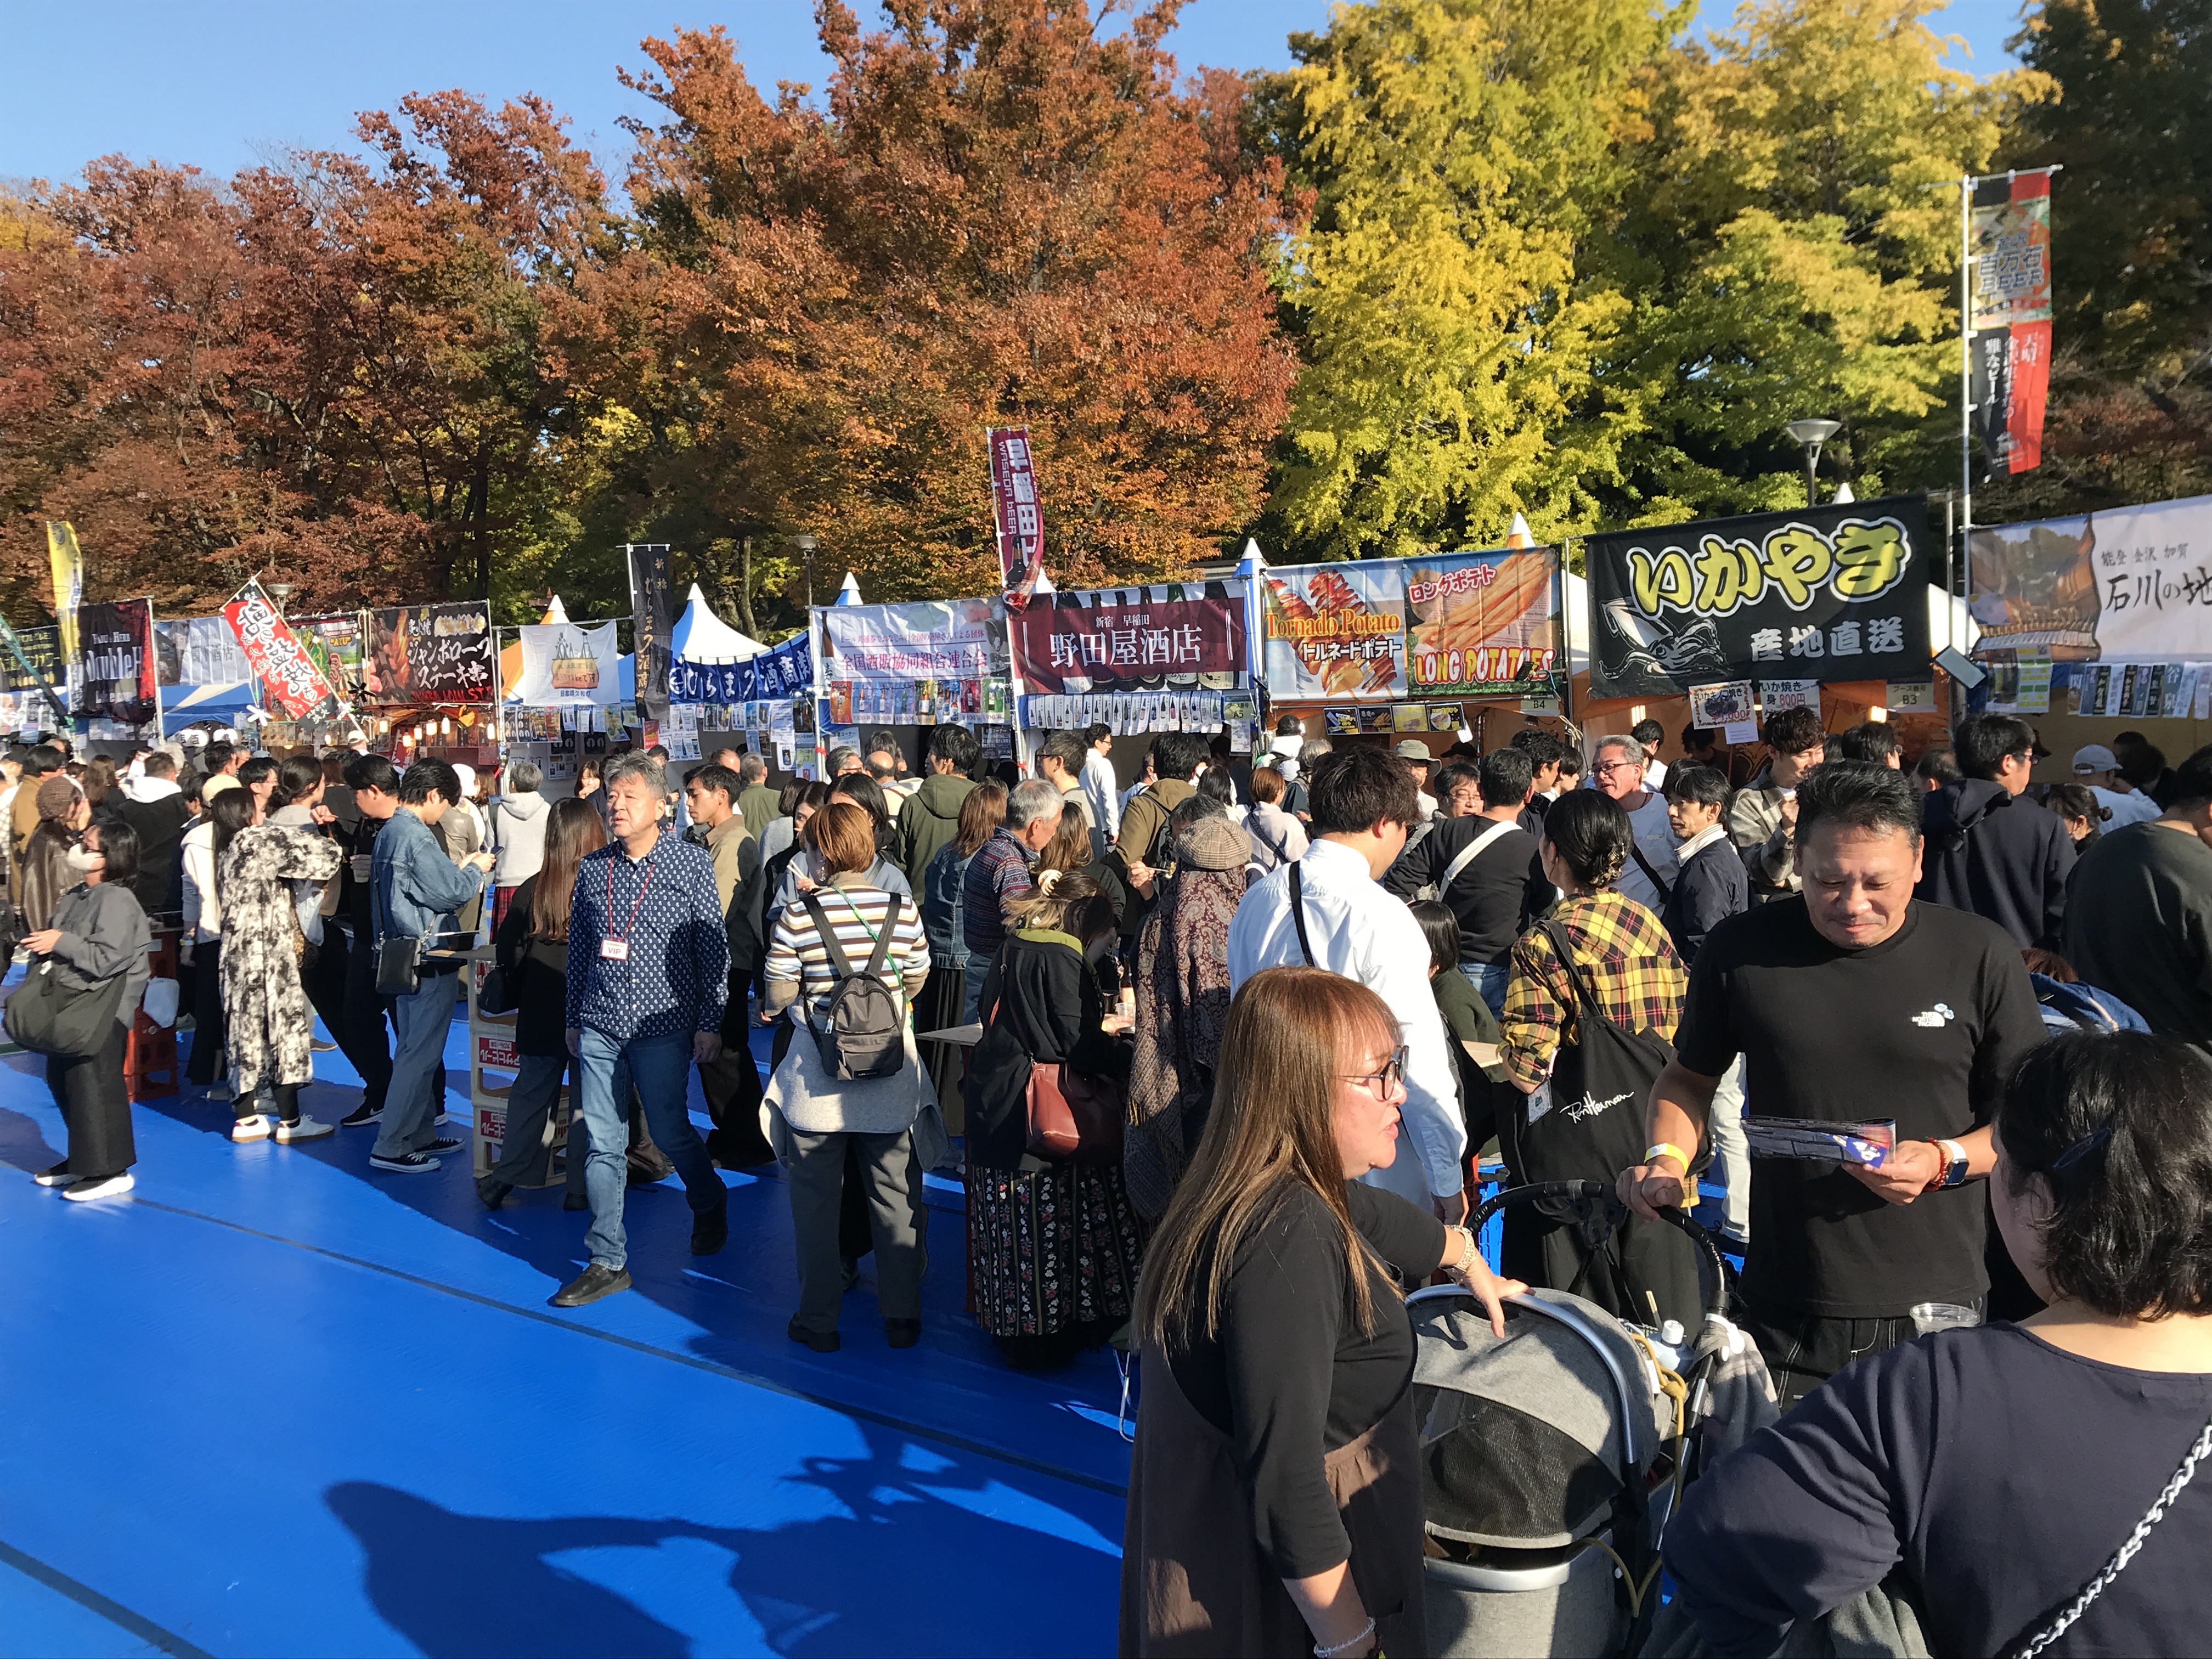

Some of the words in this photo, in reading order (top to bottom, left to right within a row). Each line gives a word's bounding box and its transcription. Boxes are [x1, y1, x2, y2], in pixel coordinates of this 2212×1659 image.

[1980, 245, 2045, 274] 百万石
[1981, 269, 2043, 292] BEER
[2102, 549, 2127, 566] 能登
[2135, 546, 2157, 563] 金沢
[2164, 543, 2188, 559] 加賀
[1627, 518, 1909, 617] いかやき
[1410, 564, 1497, 603] ロングポテト
[2105, 566, 2212, 613] 石川の地
[1095, 617, 1113, 629] 新宿
[1123, 614, 1150, 627] 早稲田
[1266, 611, 1338, 637] Tornado
[1340, 609, 1401, 634] Potato
[1049, 624, 1203, 668] 野田屋酒店
[1302, 639, 1402, 662] トルネードポテト
[1751, 616, 1904, 662] 産地直送
[408, 637, 497, 665] ジャンボロース
[842, 648, 987, 671] 全国酒販協同組合連合会
[418, 661, 489, 689] ステーキ串
[1415, 651, 1462, 683] LONG
[1464, 647, 1556, 681] POTATOES
[1697, 689, 1743, 702] いかキノコ焼き
[1760, 681, 1802, 692] いか焼き
[1533, 701, 1545, 709] B4
[1767, 694, 1776, 705] 身
[1780, 693, 1805, 706] 800円
[1903, 694, 1917, 705] B3
[479, 1049, 520, 1066] アサヒビール
